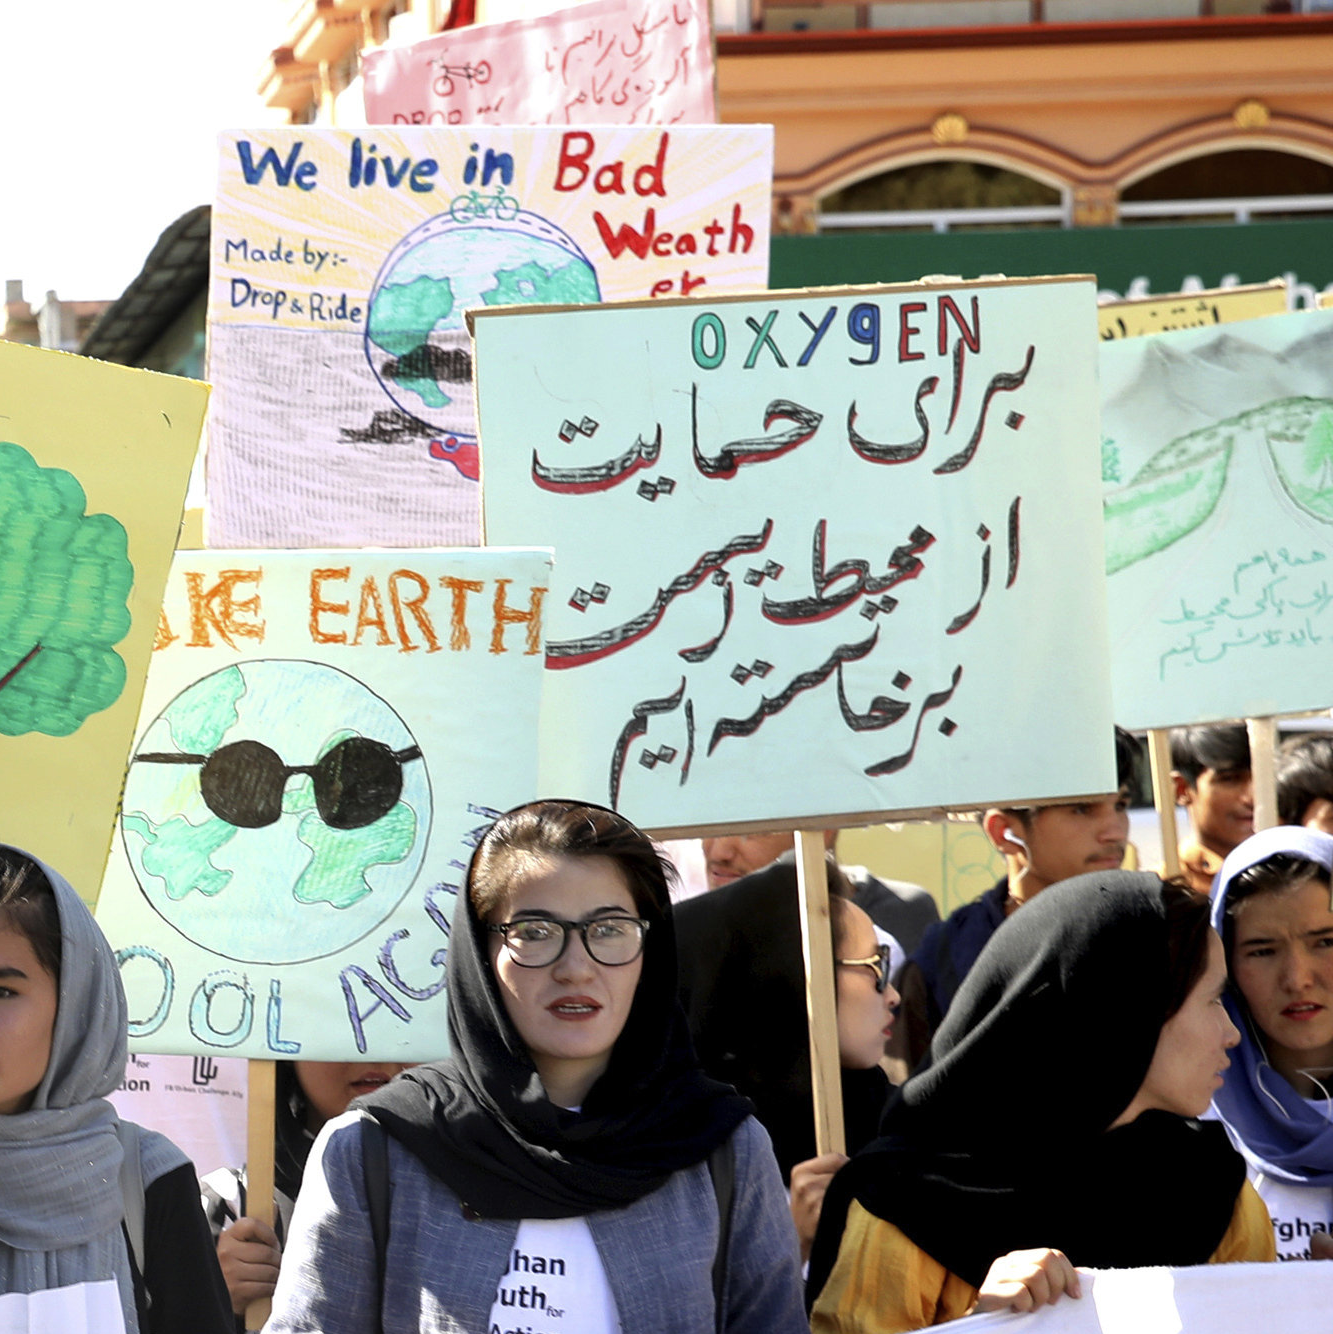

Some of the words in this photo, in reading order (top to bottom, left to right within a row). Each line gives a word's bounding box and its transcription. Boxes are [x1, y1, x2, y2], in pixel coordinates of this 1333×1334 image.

[236, 139, 318, 192] We
[349, 138, 435, 192] live
[463, 142, 514, 188] in
[553, 131, 669, 197] Bad
[224, 238, 297, 266] Made
[594, 204, 754, 261] Weath
[229, 277, 287, 319] Drop
[309, 291, 362, 323] Ride
[532, 381, 824, 501] حمایت
[847, 338, 1034, 475] برای
[761, 518, 937, 625] محیط
[945, 497, 1022, 635] از
[309, 567, 549, 655] EARTH
[115, 944, 301, 1055] OOL
[546, 1305, 565, 1318] for
